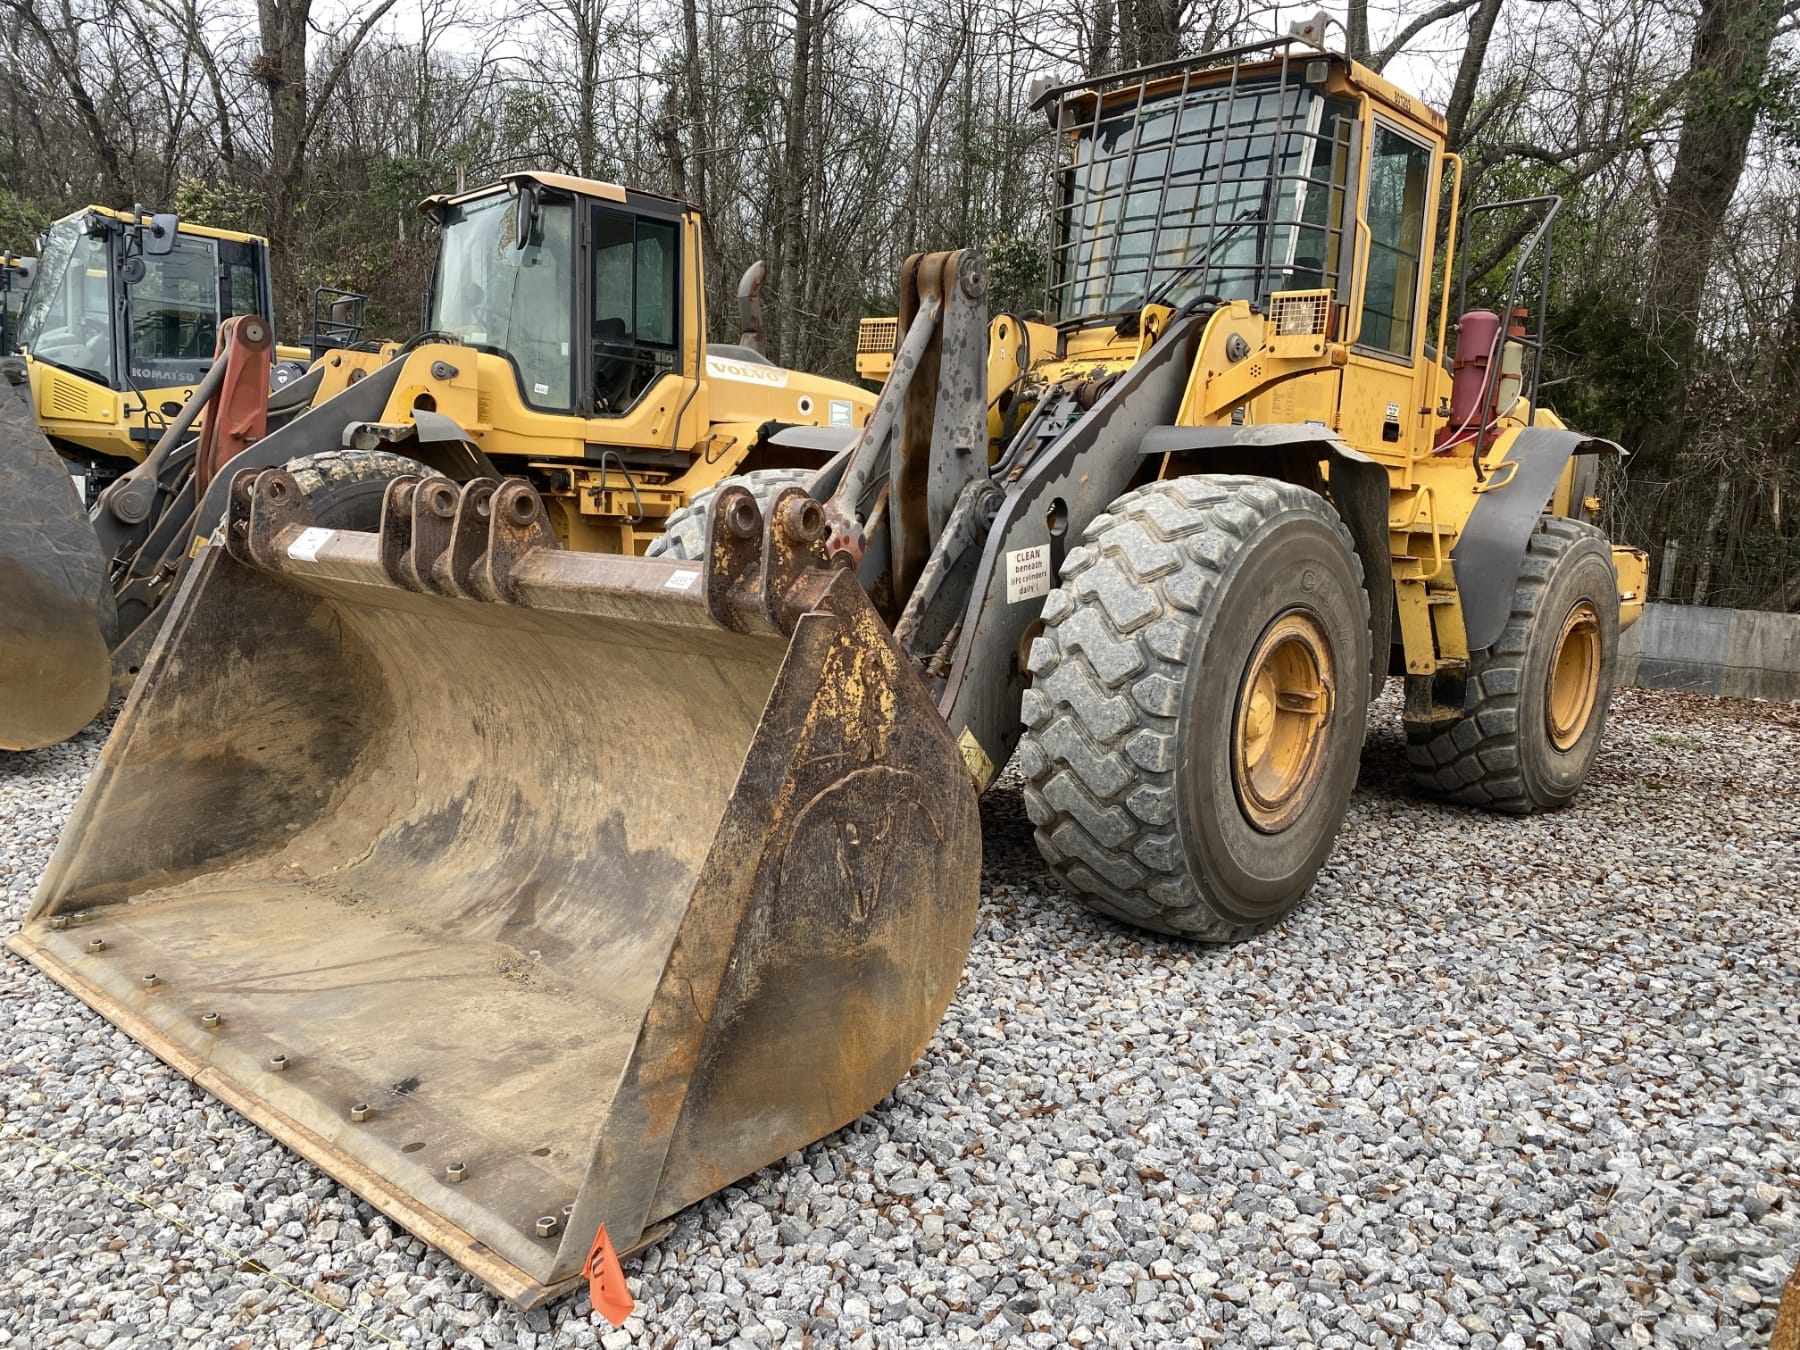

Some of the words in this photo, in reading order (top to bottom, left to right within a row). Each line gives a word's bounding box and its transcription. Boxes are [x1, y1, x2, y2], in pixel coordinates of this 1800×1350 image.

[131, 367, 195, 381] KOMATSU
[709, 361, 779, 382] VOLVO
[1016, 549, 1040, 562] CLEAN
[1015, 561, 1042, 573] beneath
